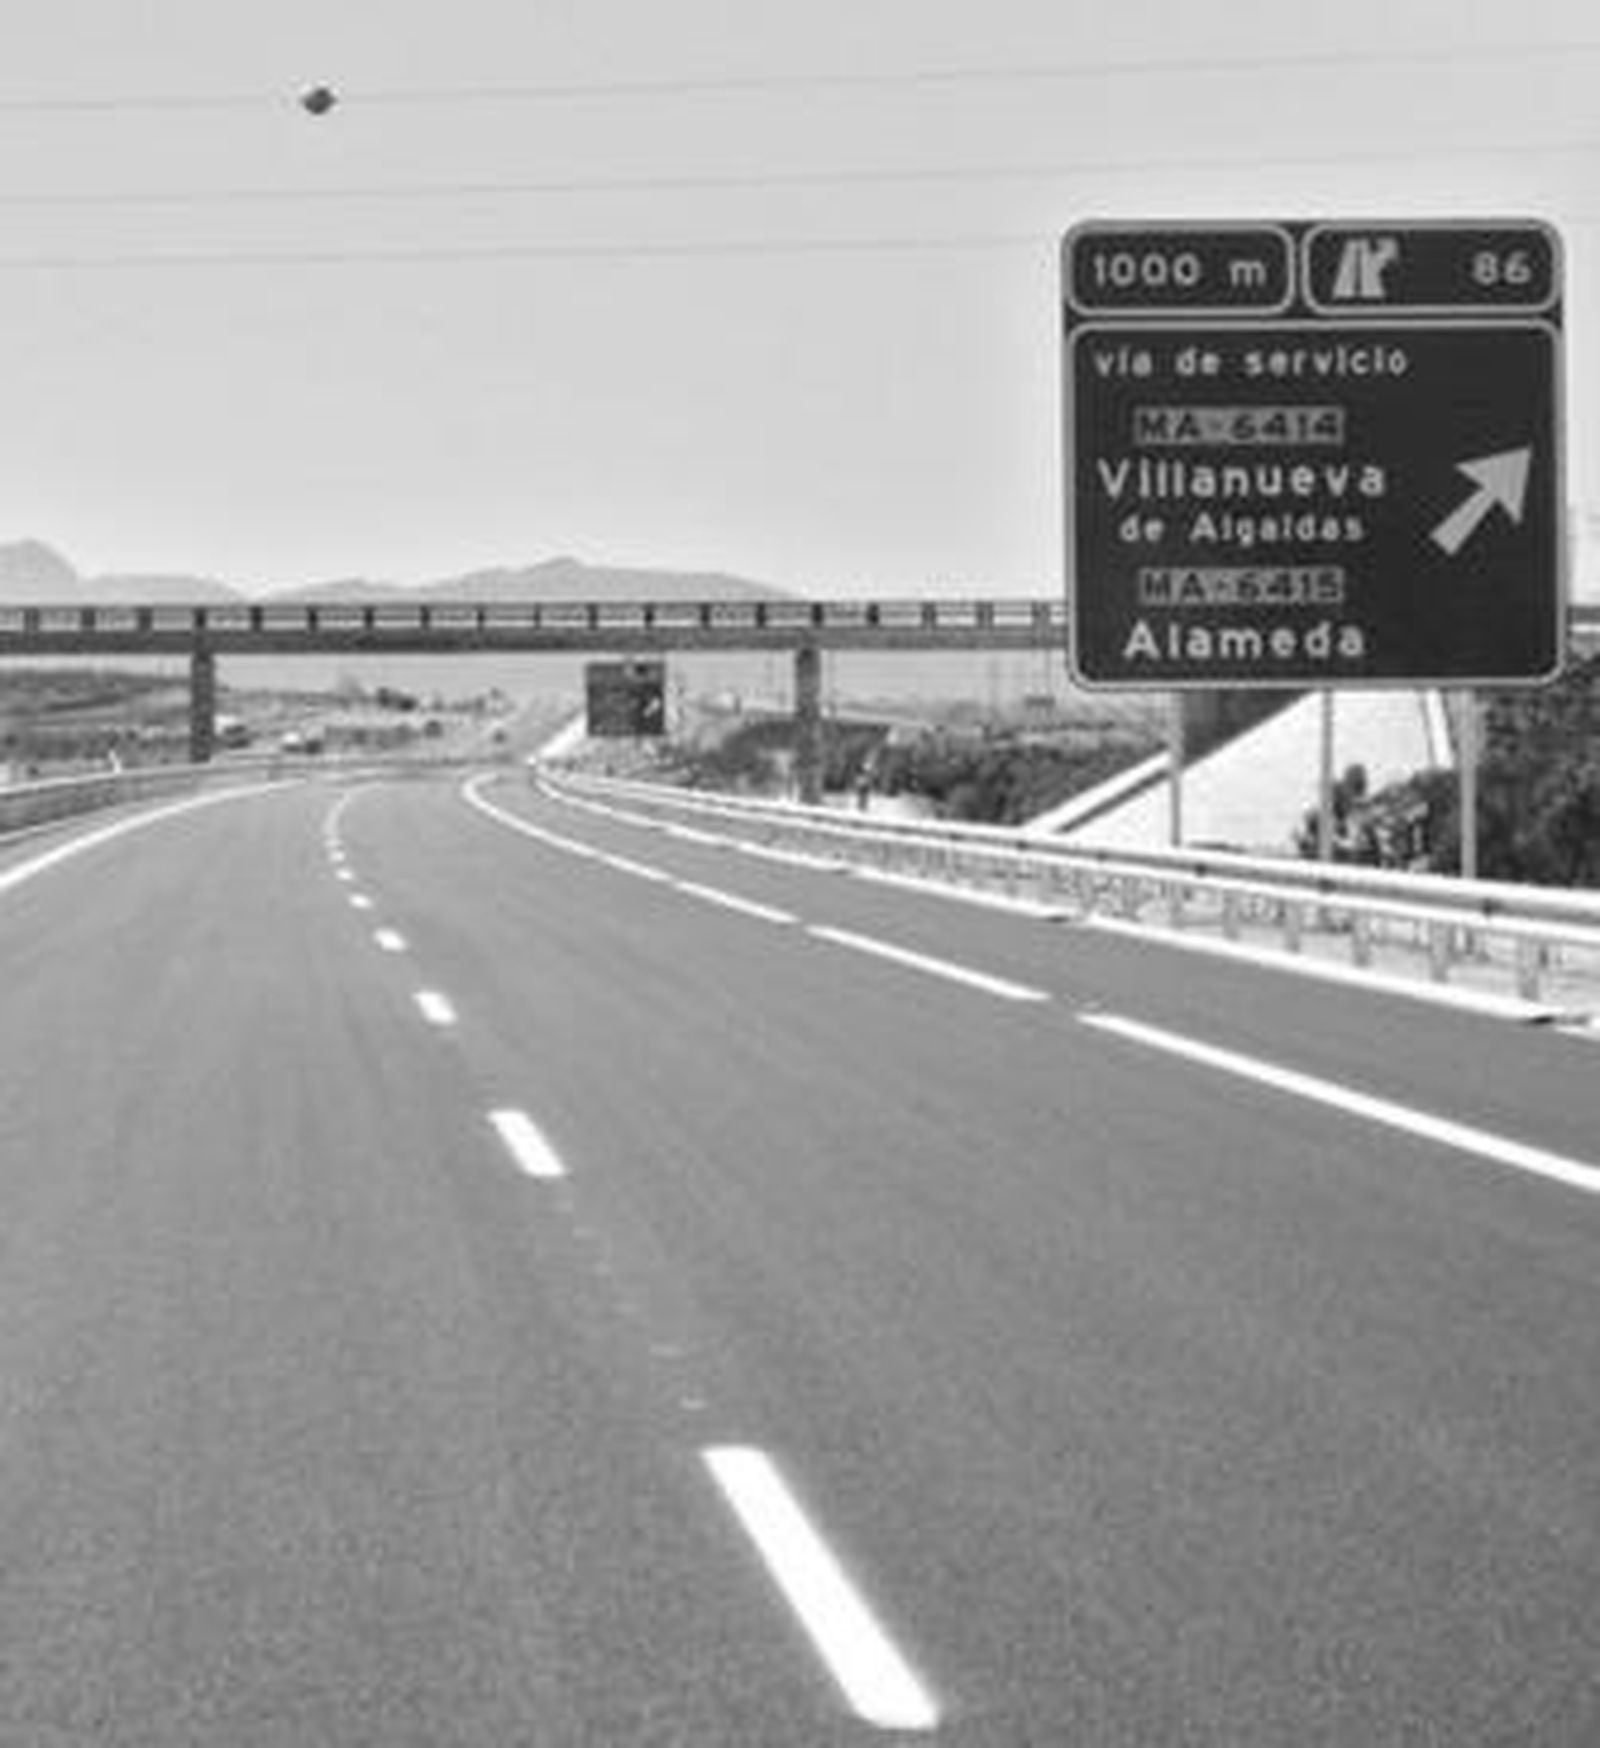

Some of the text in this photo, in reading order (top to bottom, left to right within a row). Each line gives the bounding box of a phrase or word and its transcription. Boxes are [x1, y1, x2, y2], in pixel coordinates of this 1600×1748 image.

[1094, 253, 1266, 286] 1000 m
[1473, 252, 1532, 285] 86
[1176, 347, 1222, 375] de
[1244, 347, 1408, 376] servicio
[1099, 458, 1385, 497] Villanueva
[1120, 514, 1364, 547] de Algaidas
[1124, 621, 1366, 659] Alameda
